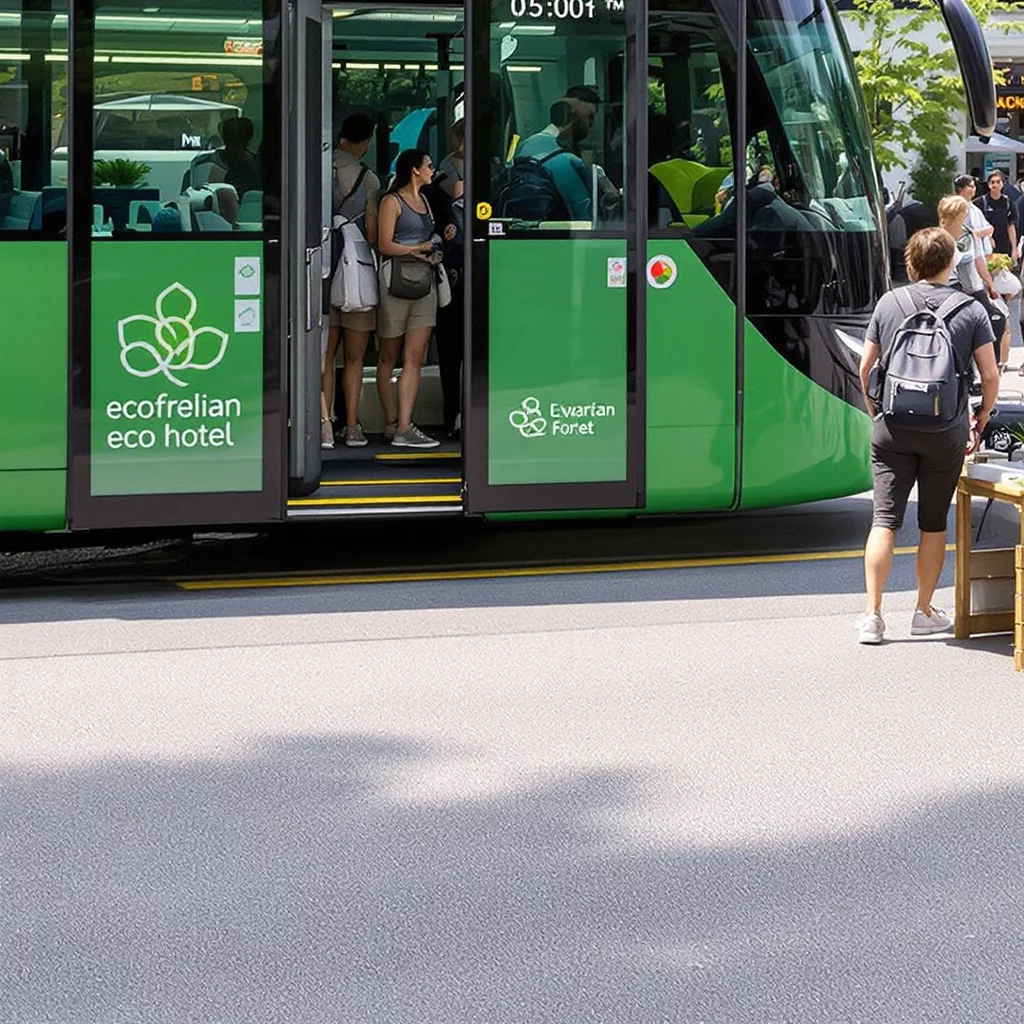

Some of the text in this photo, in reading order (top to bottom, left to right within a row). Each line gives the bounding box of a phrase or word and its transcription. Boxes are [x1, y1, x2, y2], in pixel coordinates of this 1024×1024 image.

[106, 392, 241, 419] ecofrelian
[107, 421, 235, 449] eco hotel
